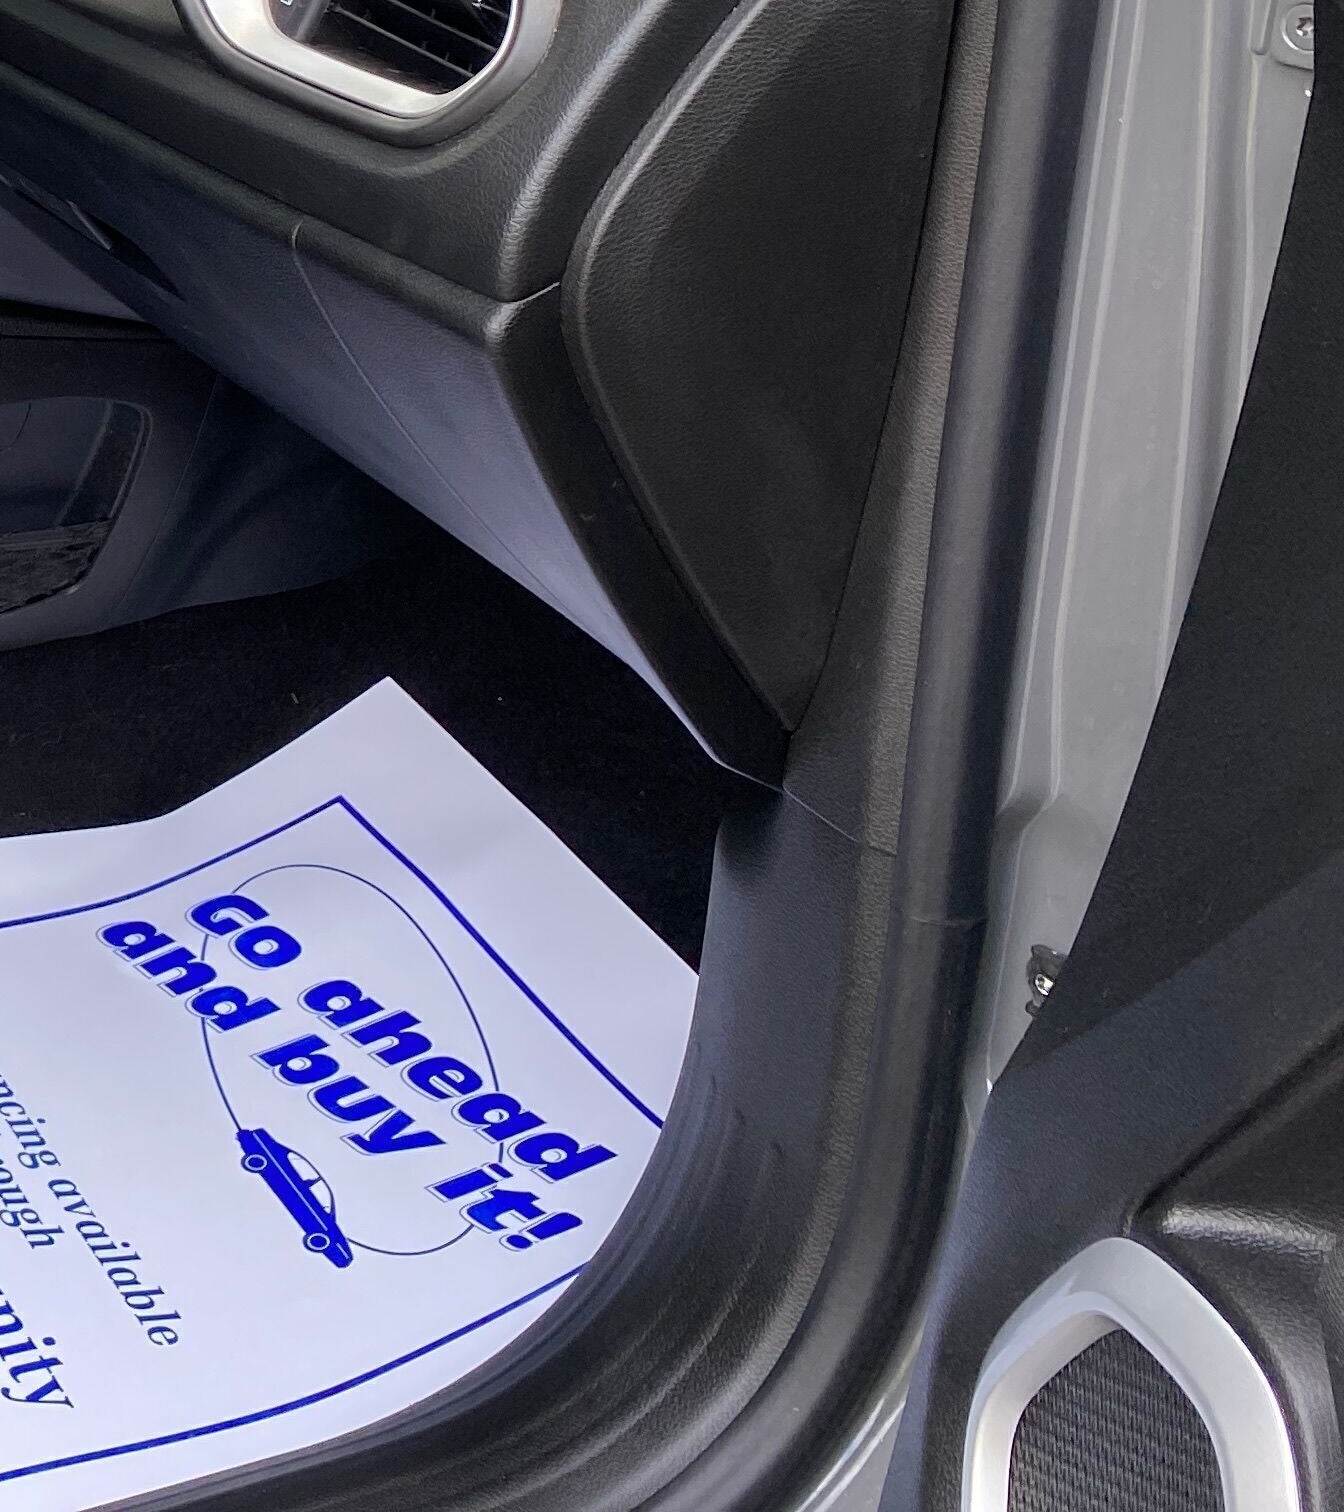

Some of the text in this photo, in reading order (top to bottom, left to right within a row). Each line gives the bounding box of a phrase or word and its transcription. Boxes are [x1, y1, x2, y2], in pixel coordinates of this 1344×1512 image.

[98, 921, 583, 1252] and buy it!
[299, 979, 619, 1184] ahead
[46, 1178, 180, 1347] available
